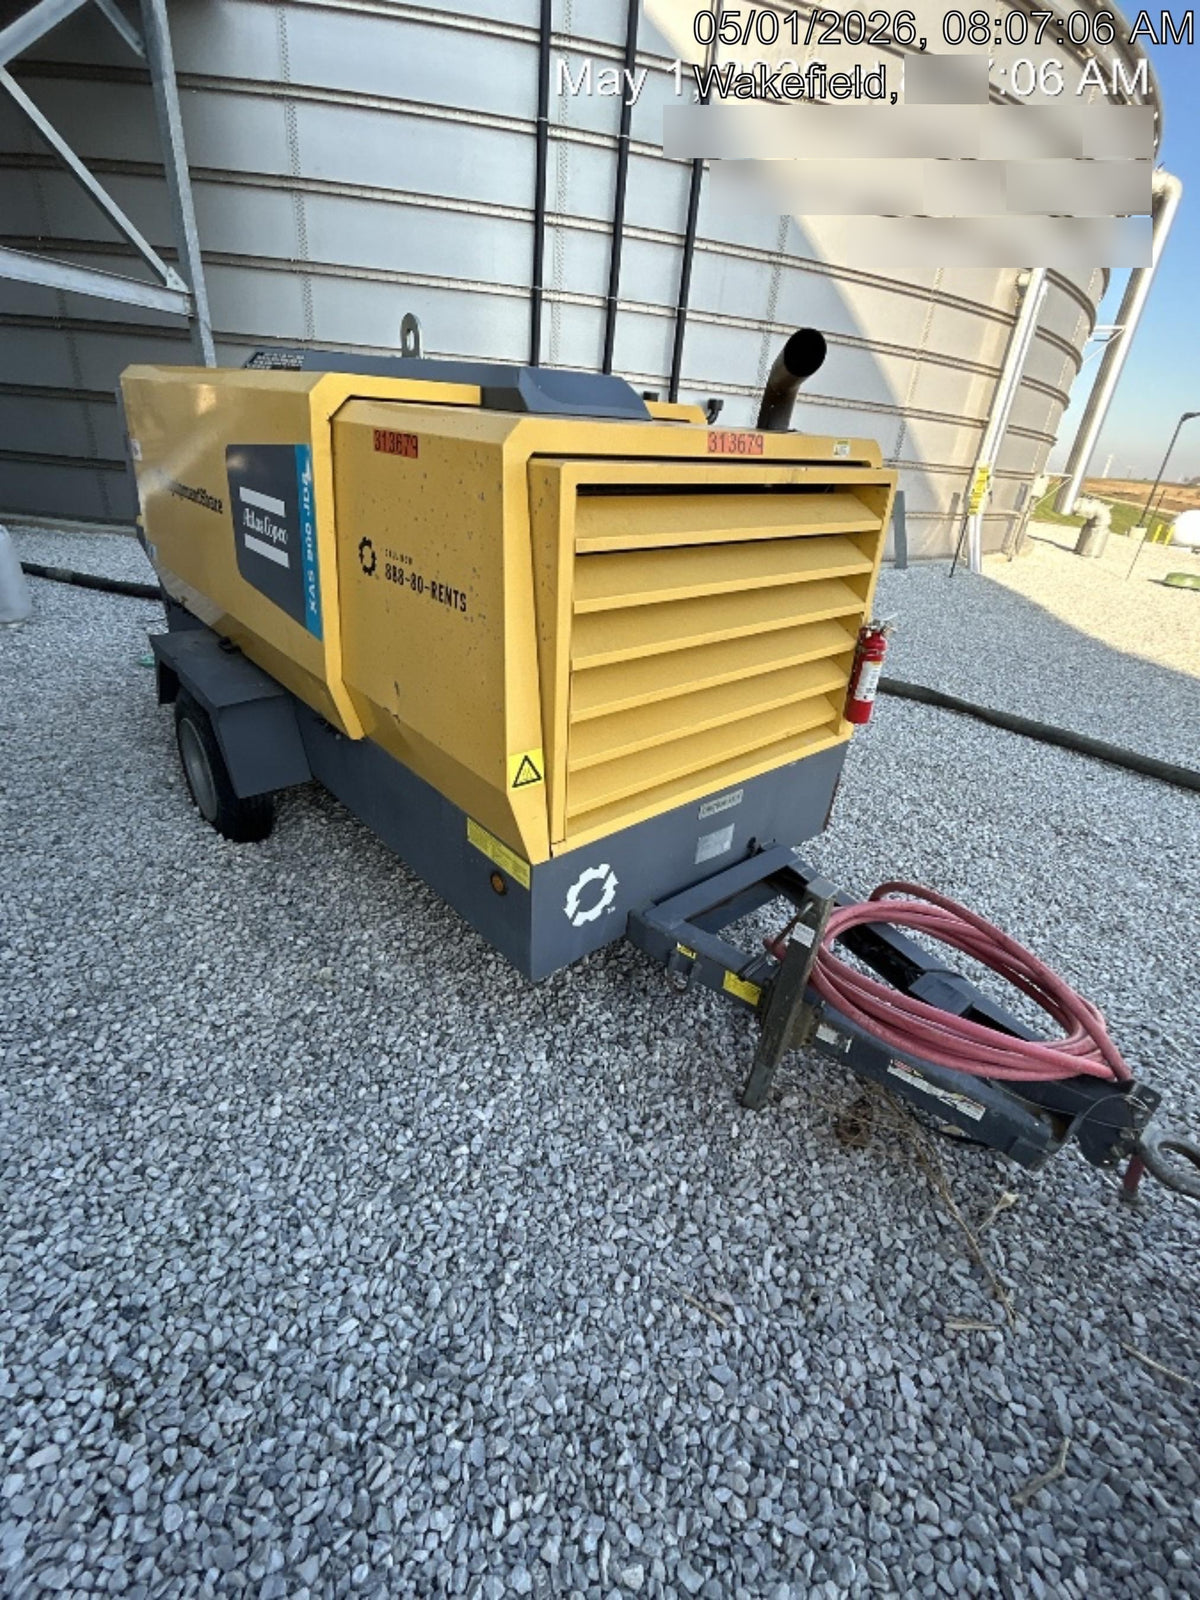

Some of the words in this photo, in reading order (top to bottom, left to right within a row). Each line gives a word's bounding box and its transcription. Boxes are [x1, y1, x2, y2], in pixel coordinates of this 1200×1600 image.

[374, 429, 418, 459] 313679
[708, 431, 763, 455] 313679
[385, 562, 467, 613] 888-80-RENTS
